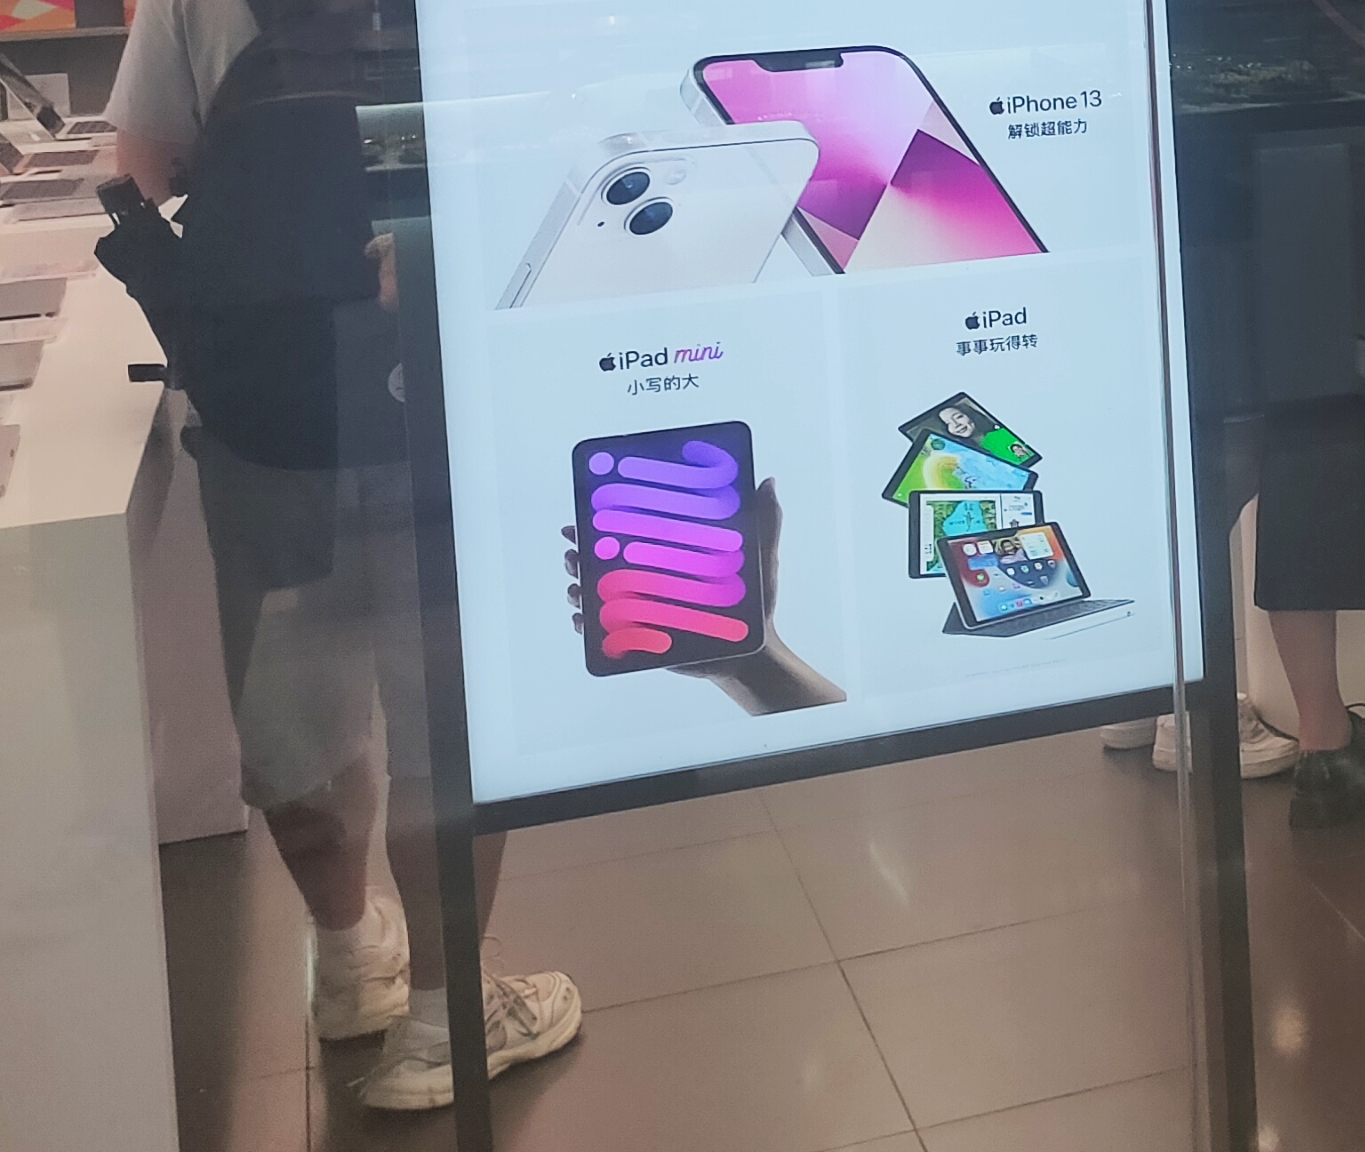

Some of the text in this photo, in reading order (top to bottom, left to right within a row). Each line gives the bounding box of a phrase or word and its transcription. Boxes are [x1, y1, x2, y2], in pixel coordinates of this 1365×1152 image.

[1007, 89, 1103, 115] iPhone 13
[1007, 118, 1088, 140] 解锁超能力
[982, 307, 1028, 330] iPad
[618, 341, 724, 371] iPad mini
[956, 333, 1038, 357] 事事玩得转
[626, 373, 701, 397] 小写的大
